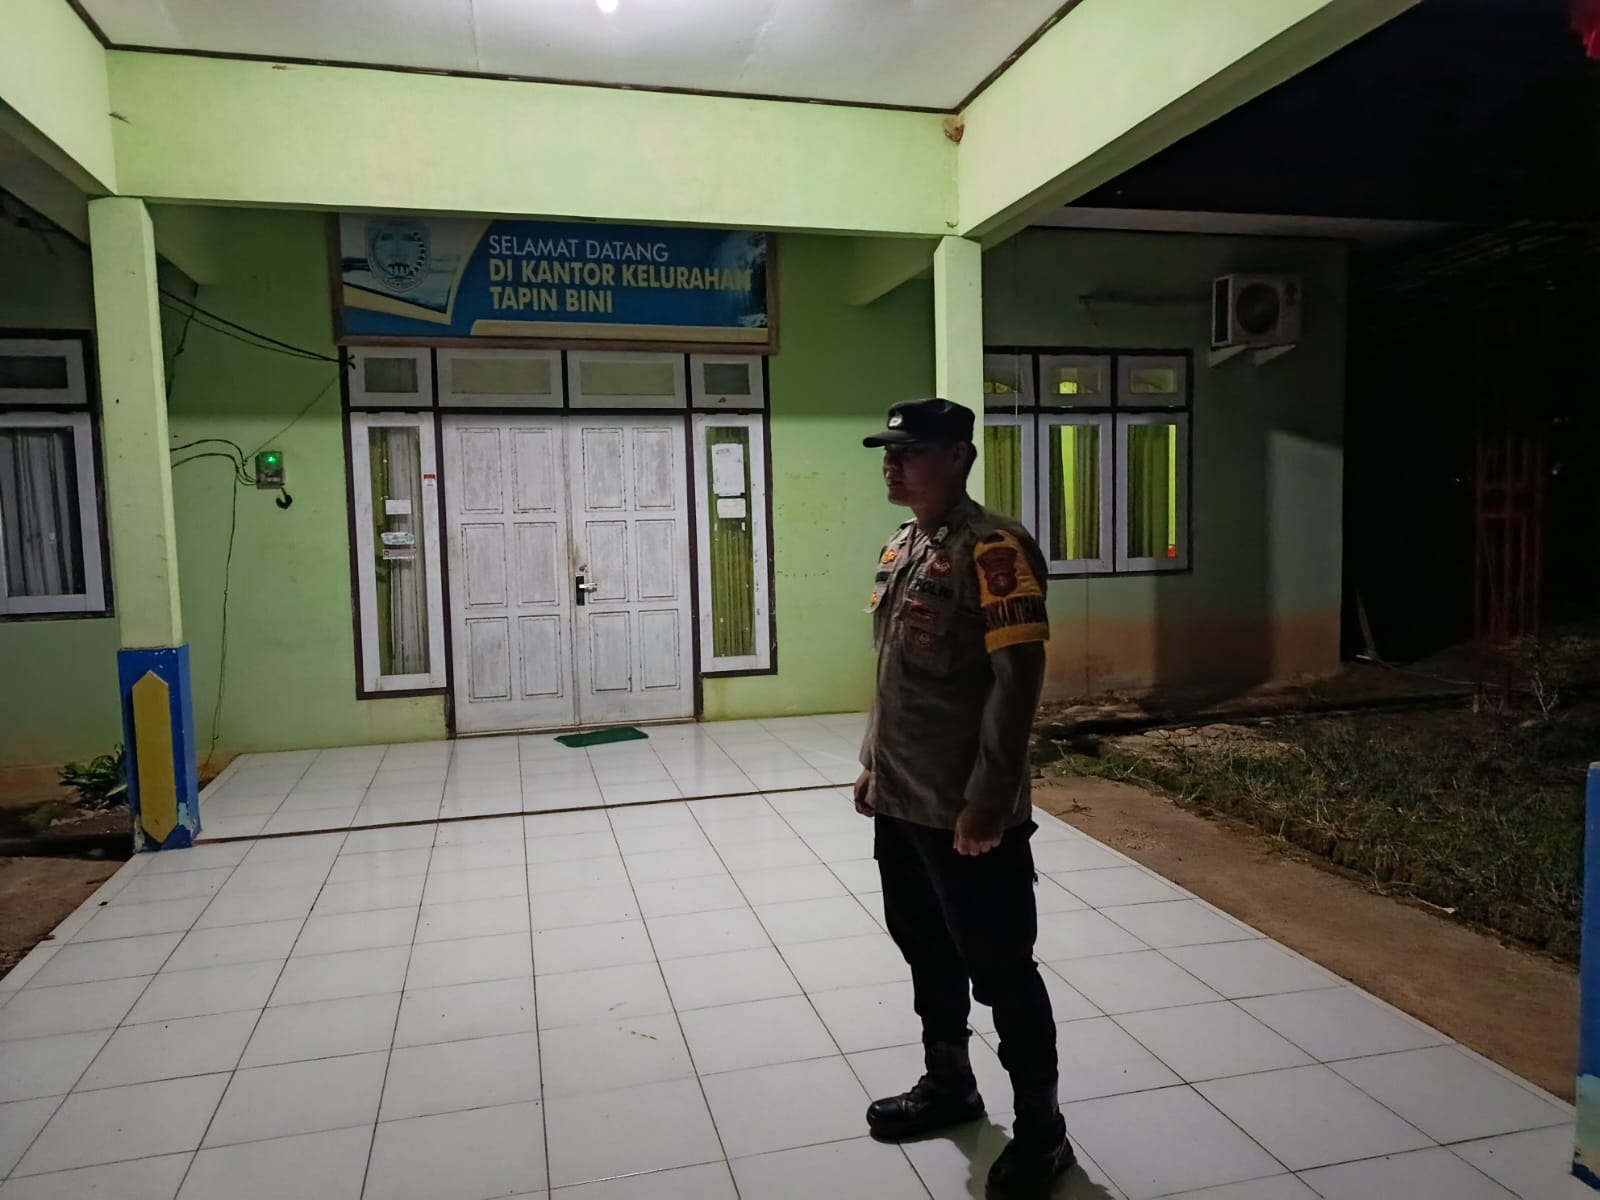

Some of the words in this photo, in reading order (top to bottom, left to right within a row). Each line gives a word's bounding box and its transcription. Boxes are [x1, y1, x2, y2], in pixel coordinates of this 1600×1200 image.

[489, 235, 577, 258] SELAMAT
[586, 241, 669, 262] DATANG
[490, 259, 513, 282] DI
[522, 261, 615, 286] KANTOR
[622, 266, 752, 291] KELURAHAN
[491, 287, 558, 311] TAPIN
[567, 291, 613, 313] BINI
